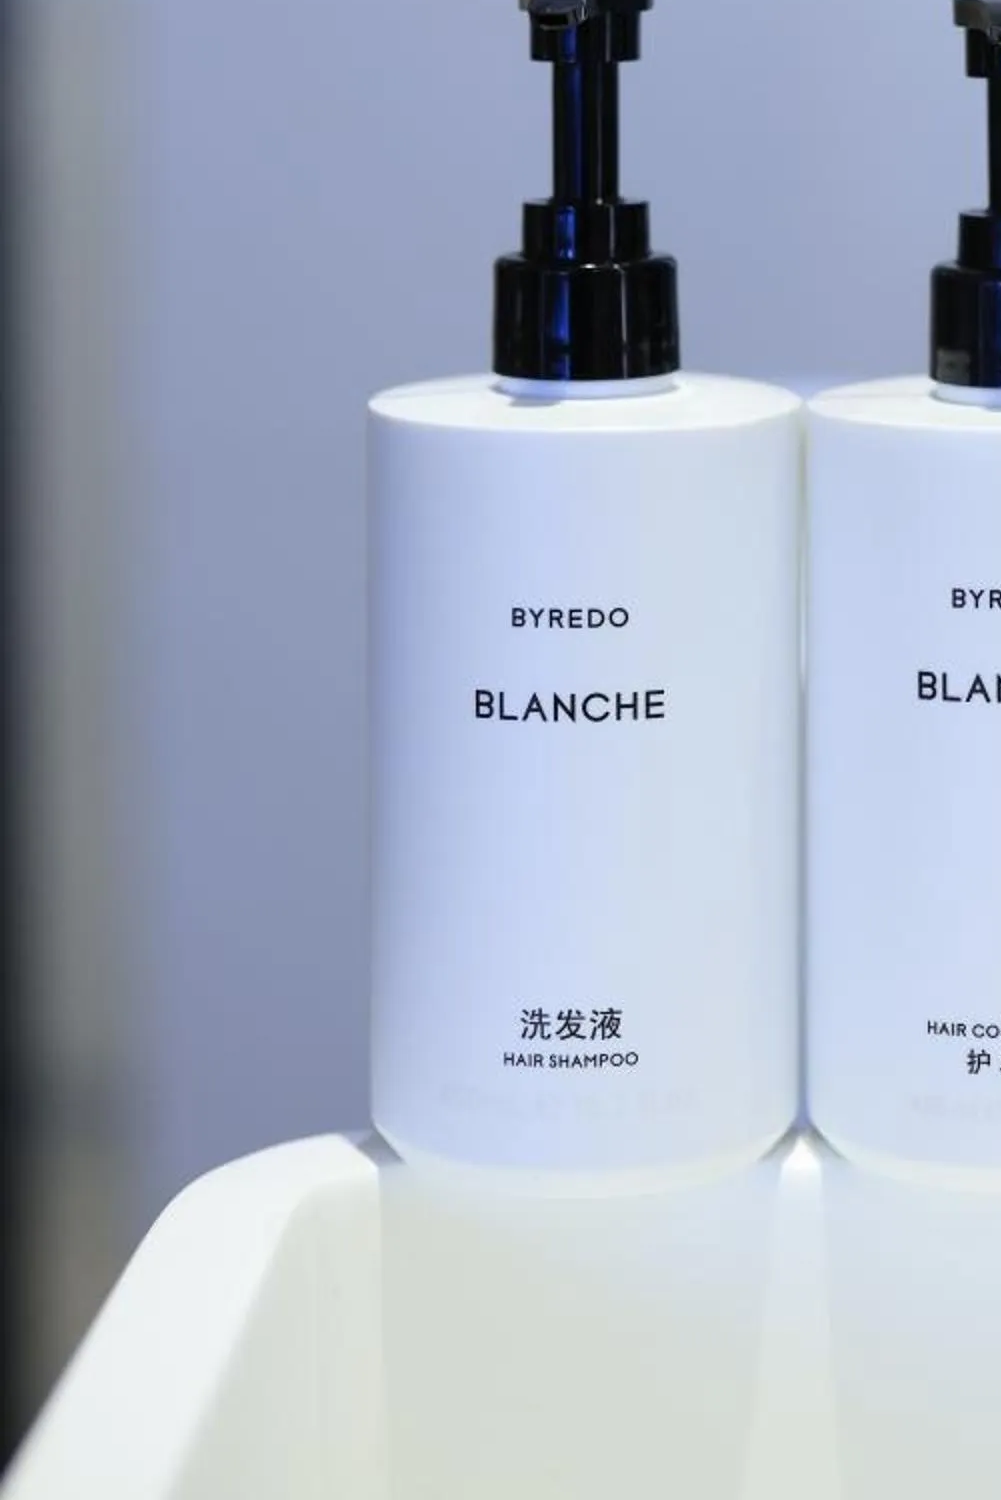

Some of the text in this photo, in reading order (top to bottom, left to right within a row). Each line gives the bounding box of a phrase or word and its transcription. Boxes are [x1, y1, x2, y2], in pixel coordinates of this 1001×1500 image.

[511, 606, 630, 629] BYREDO
[474, 688, 666, 723] BLANCHE
[519, 1006, 623, 1041] 洗发液
[927, 1019, 967, 1038] HAIR
[503, 1051, 639, 1069] HAIR SHAMPOO
